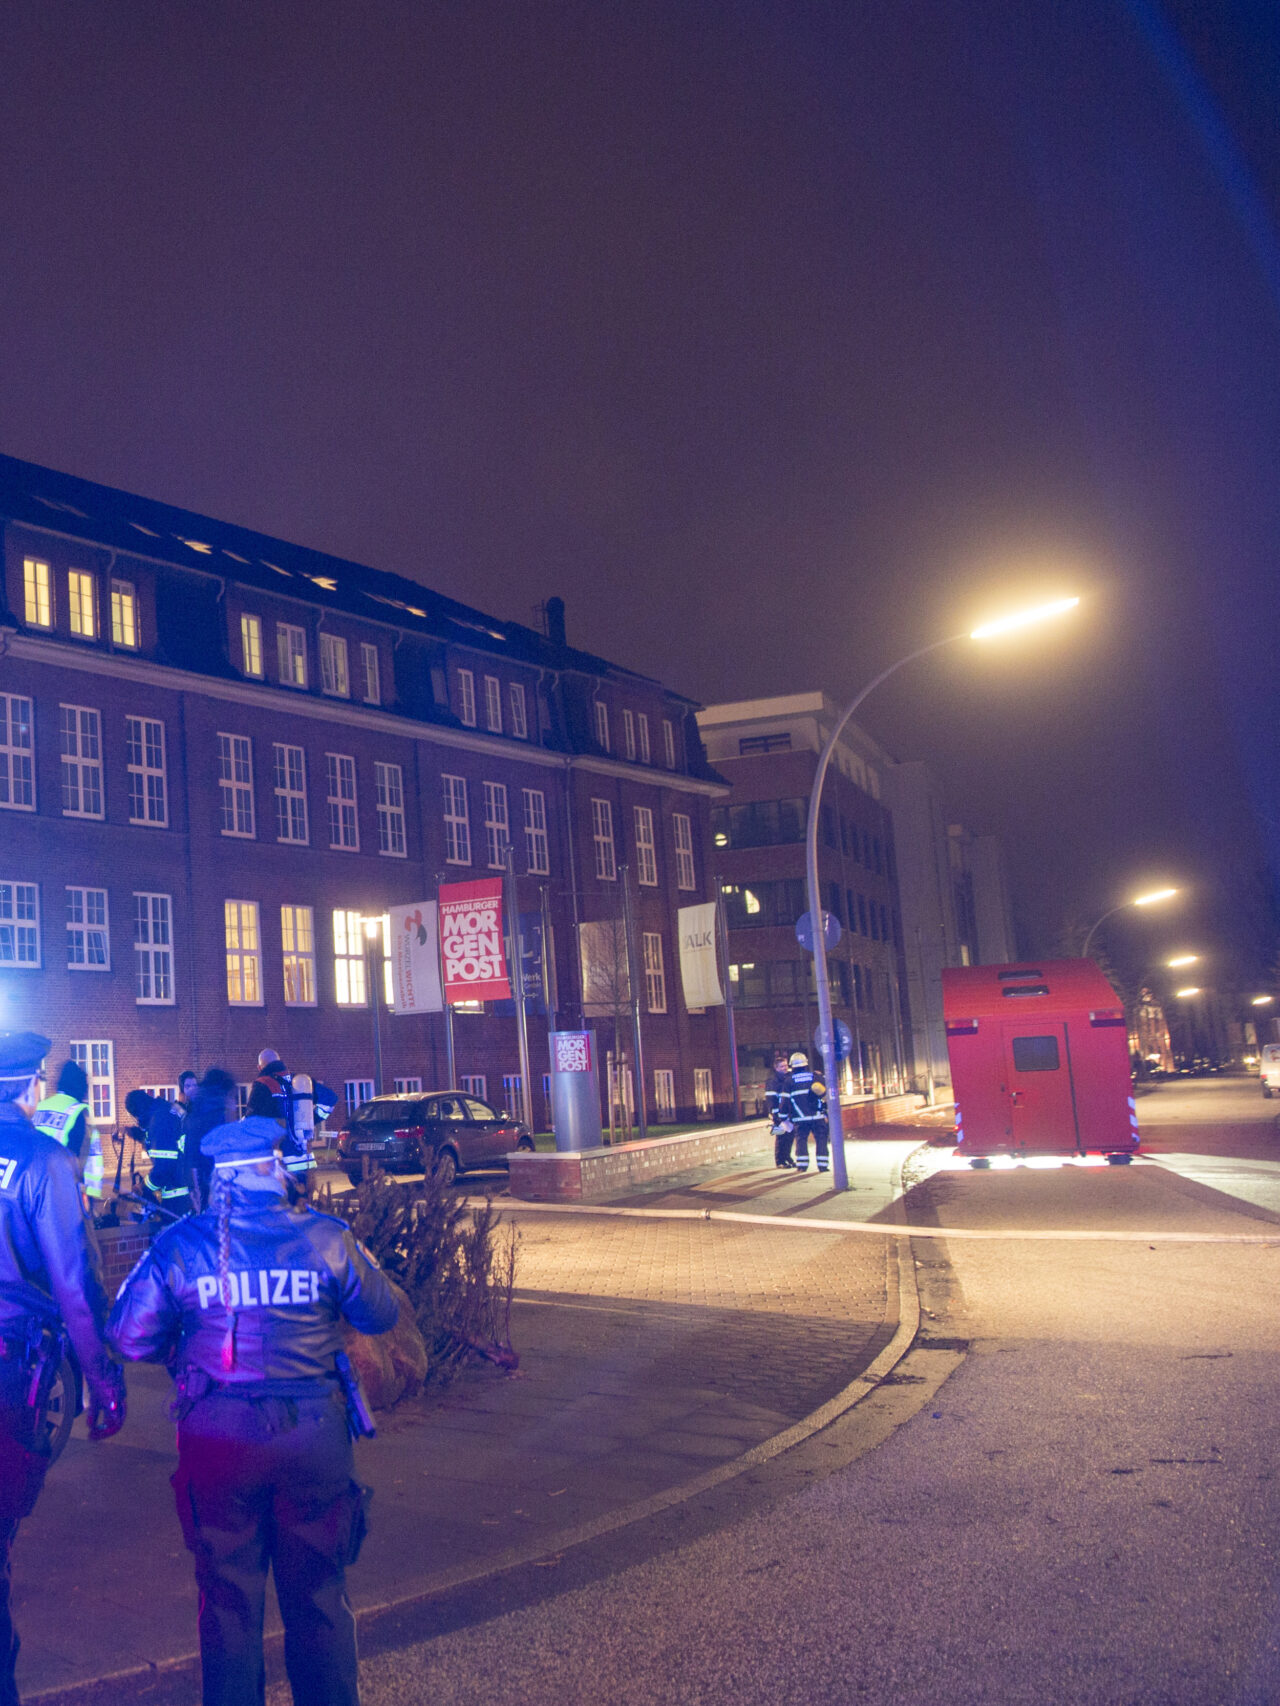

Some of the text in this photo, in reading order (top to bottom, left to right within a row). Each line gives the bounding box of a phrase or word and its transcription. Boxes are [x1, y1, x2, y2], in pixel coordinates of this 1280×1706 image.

[442, 901, 498, 914] HAMBURGER
[443, 910, 499, 937] MOR
[444, 932, 500, 959] GEN
[685, 931, 712, 949] ALK
[445, 955, 502, 981] POST
[558, 1039, 585, 1051] MOR
[558, 1050, 586, 1061] GEN
[560, 1060, 588, 1072] POST
[197, 1269, 320, 1309] POLIZEI
